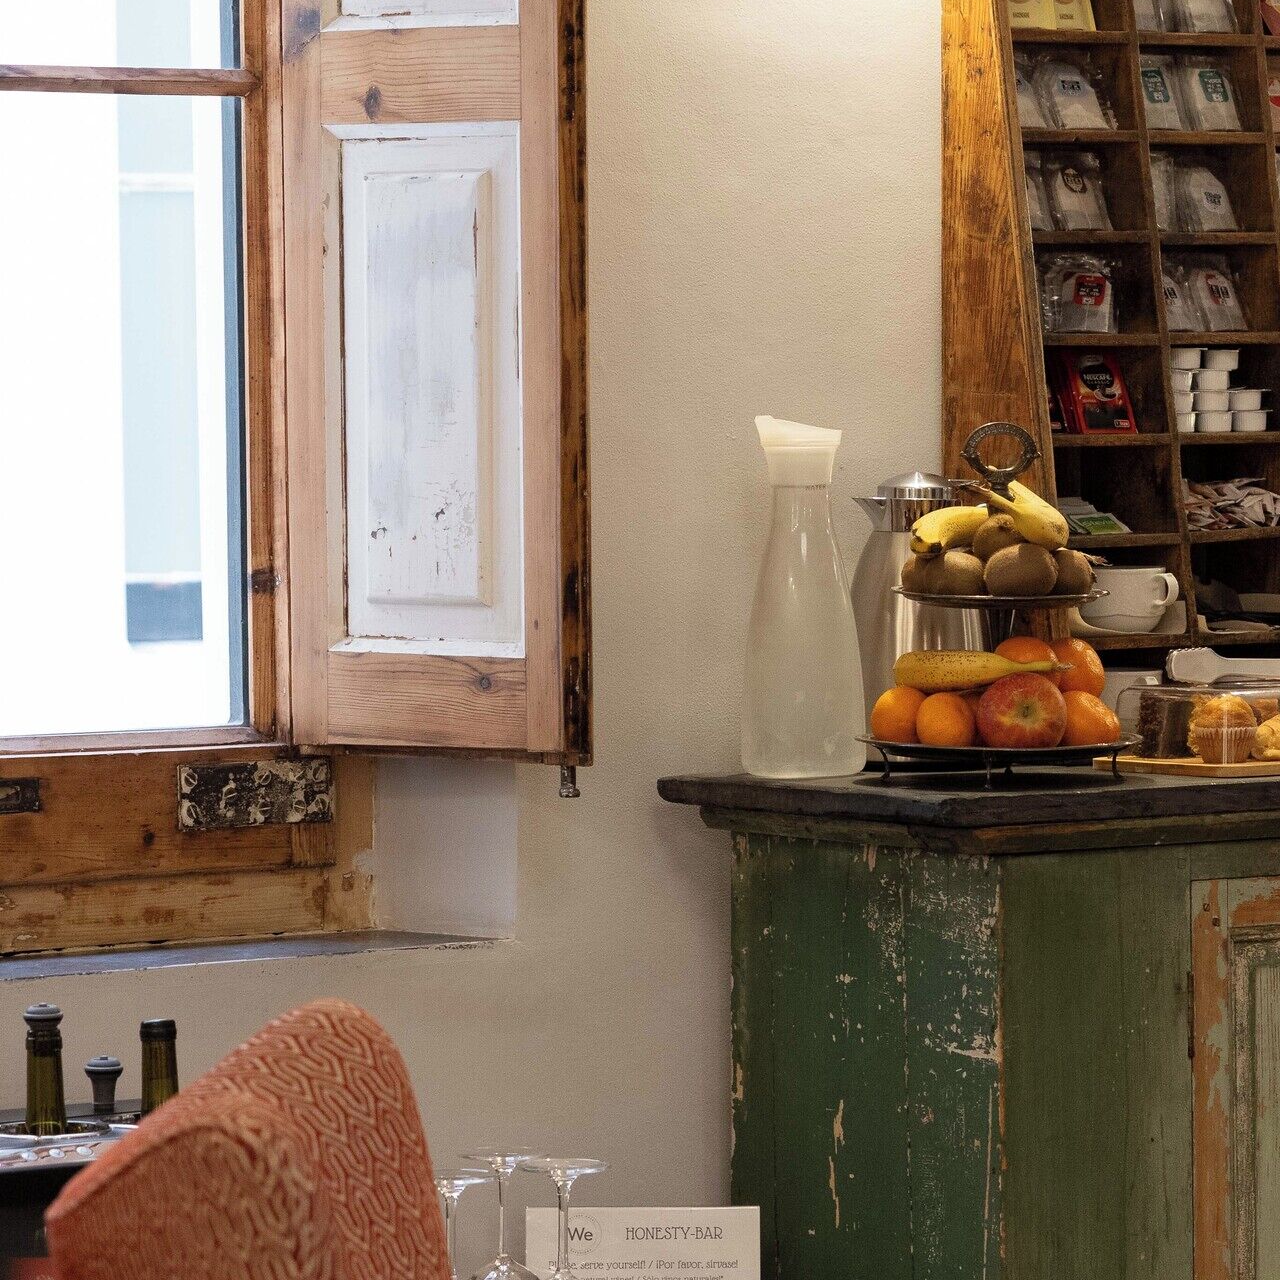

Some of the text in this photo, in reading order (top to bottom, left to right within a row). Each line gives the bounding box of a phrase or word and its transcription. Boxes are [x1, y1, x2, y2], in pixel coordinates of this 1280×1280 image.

[567, 1226, 593, 1242] We
[625, 1226, 723, 1241] HONESTY-BAR
[580, 1261, 604, 1270] serve
[605, 1260, 646, 1271] yourself!
[677, 1260, 704, 1270] favor,
